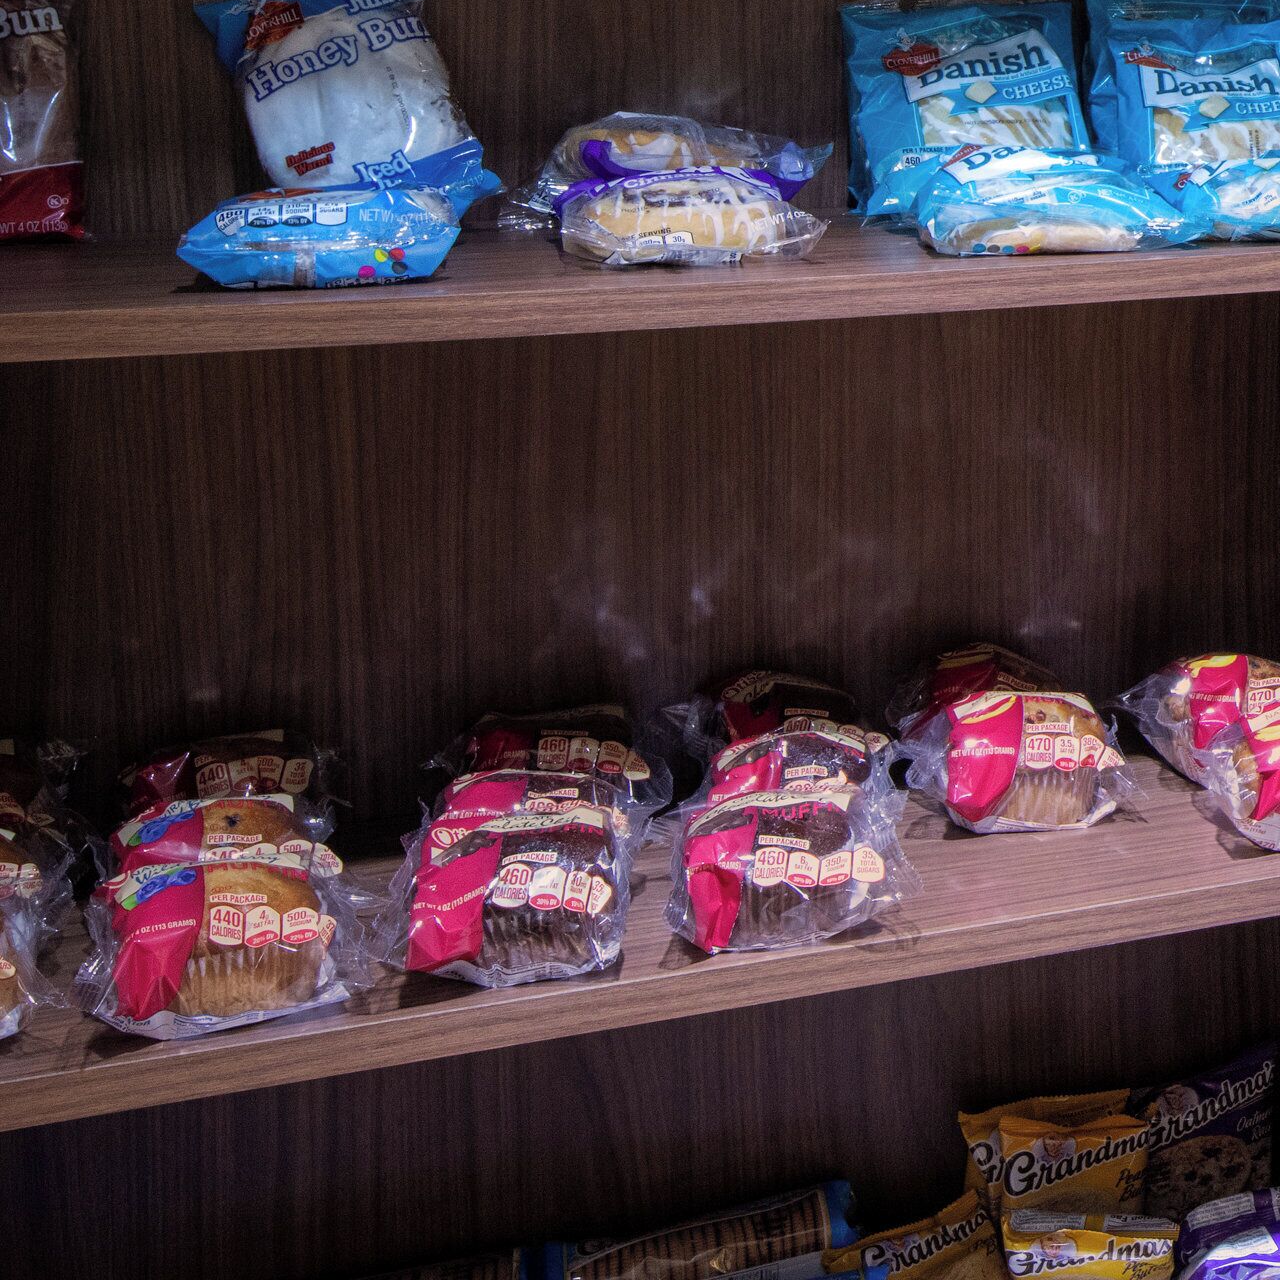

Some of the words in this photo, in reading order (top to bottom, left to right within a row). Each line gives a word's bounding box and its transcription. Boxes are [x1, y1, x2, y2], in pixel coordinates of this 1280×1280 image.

[247, 36, 359, 101] Honey
[1003, 75, 1074, 99] CHEESE
[1155, 70, 1279, 96] Danish
[286, 142, 335, 166] Delicious
[353, 150, 410, 184] Iced
[905, 157, 920, 165] 460
[1028, 738, 1050, 751] 470
[1027, 752, 1051, 762] CALORIES
[776, 839, 807, 849] PACKAGE
[520, 853, 555, 861] PACKAGE
[758, 851, 785, 865] 460
[501, 868, 529, 885] 460
[755, 868, 784, 879] CALORIES
[231, 896, 265, 904] PACKAGE
[494, 888, 528, 900] CALORIES
[214, 909, 240, 927] 440
[152, 924, 166, 932] (113
[168, 919, 196, 929] GRAMS)
[212, 925, 240, 940] CALORIES
